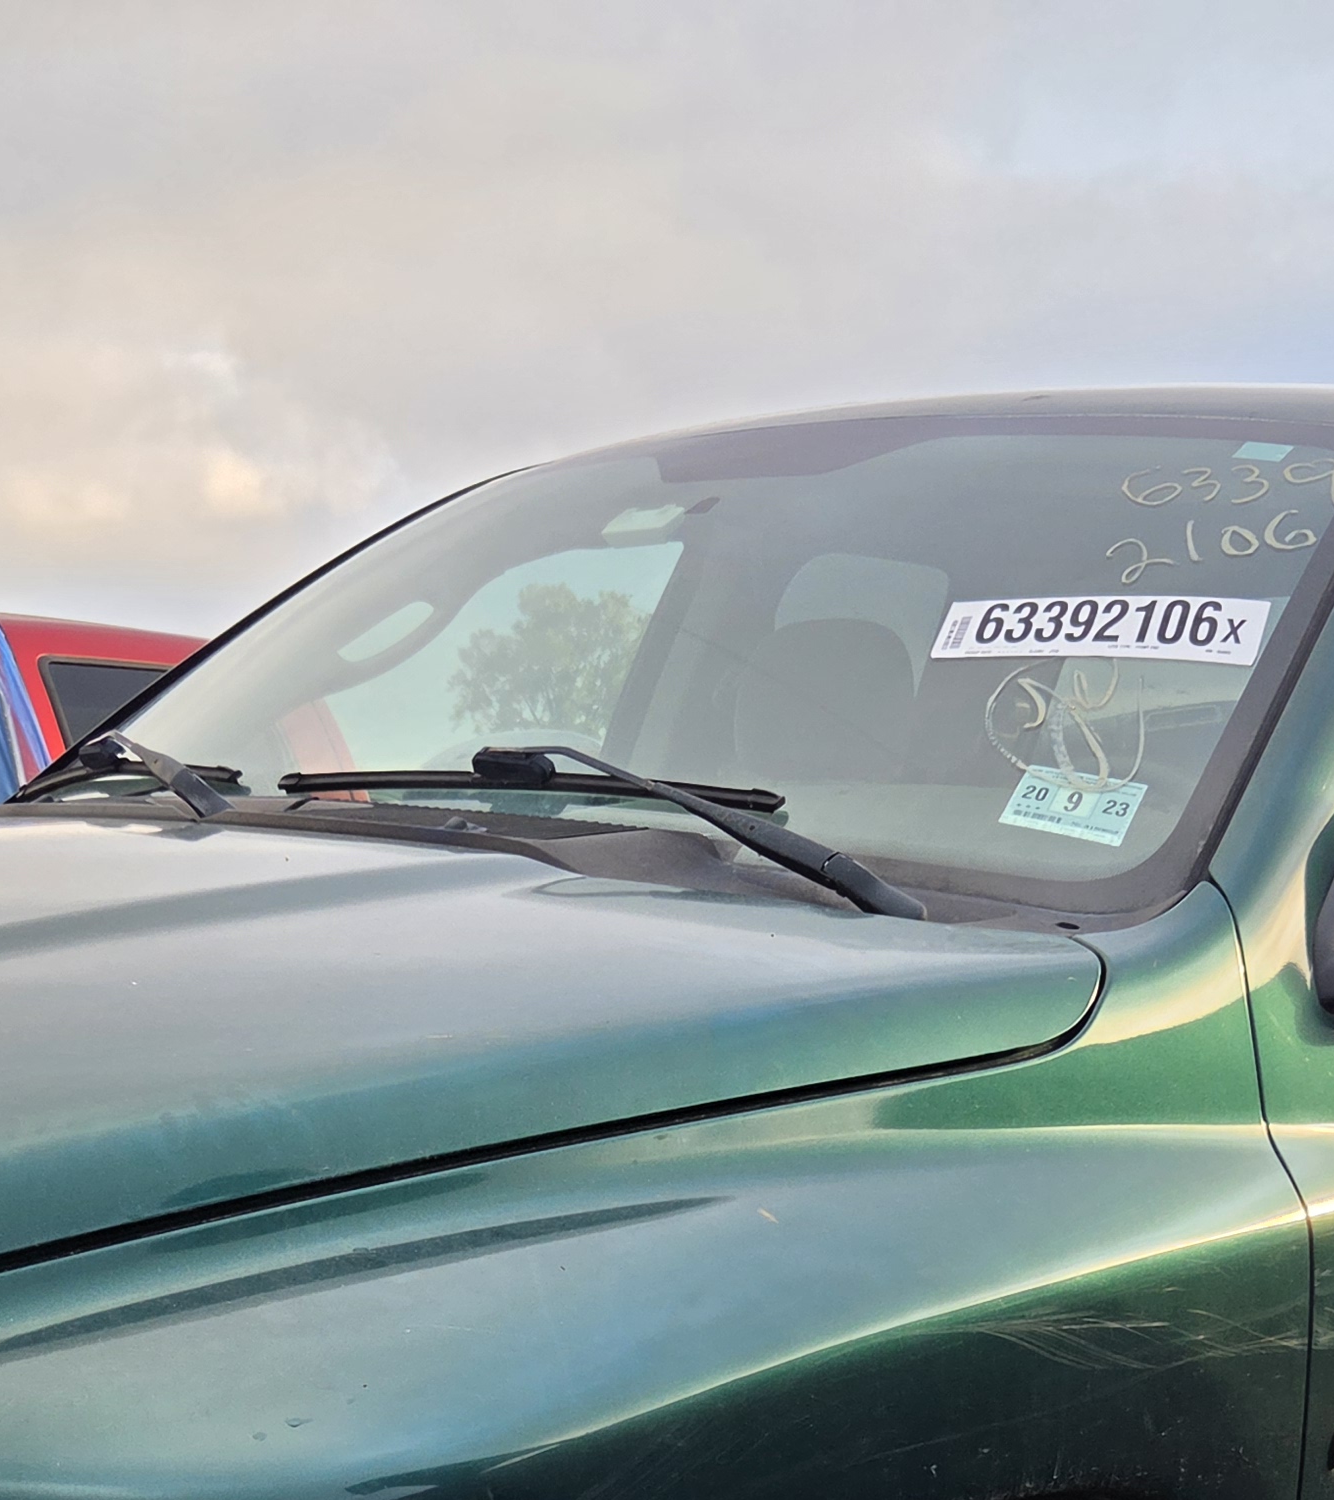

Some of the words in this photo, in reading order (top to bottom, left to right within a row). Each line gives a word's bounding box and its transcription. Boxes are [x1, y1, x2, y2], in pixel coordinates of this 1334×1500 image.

[1106, 510, 1317, 584] 2106
[1021, 785, 1049, 801] 20
[1063, 791, 1083, 812] 9
[1102, 800, 1130, 817] 23
